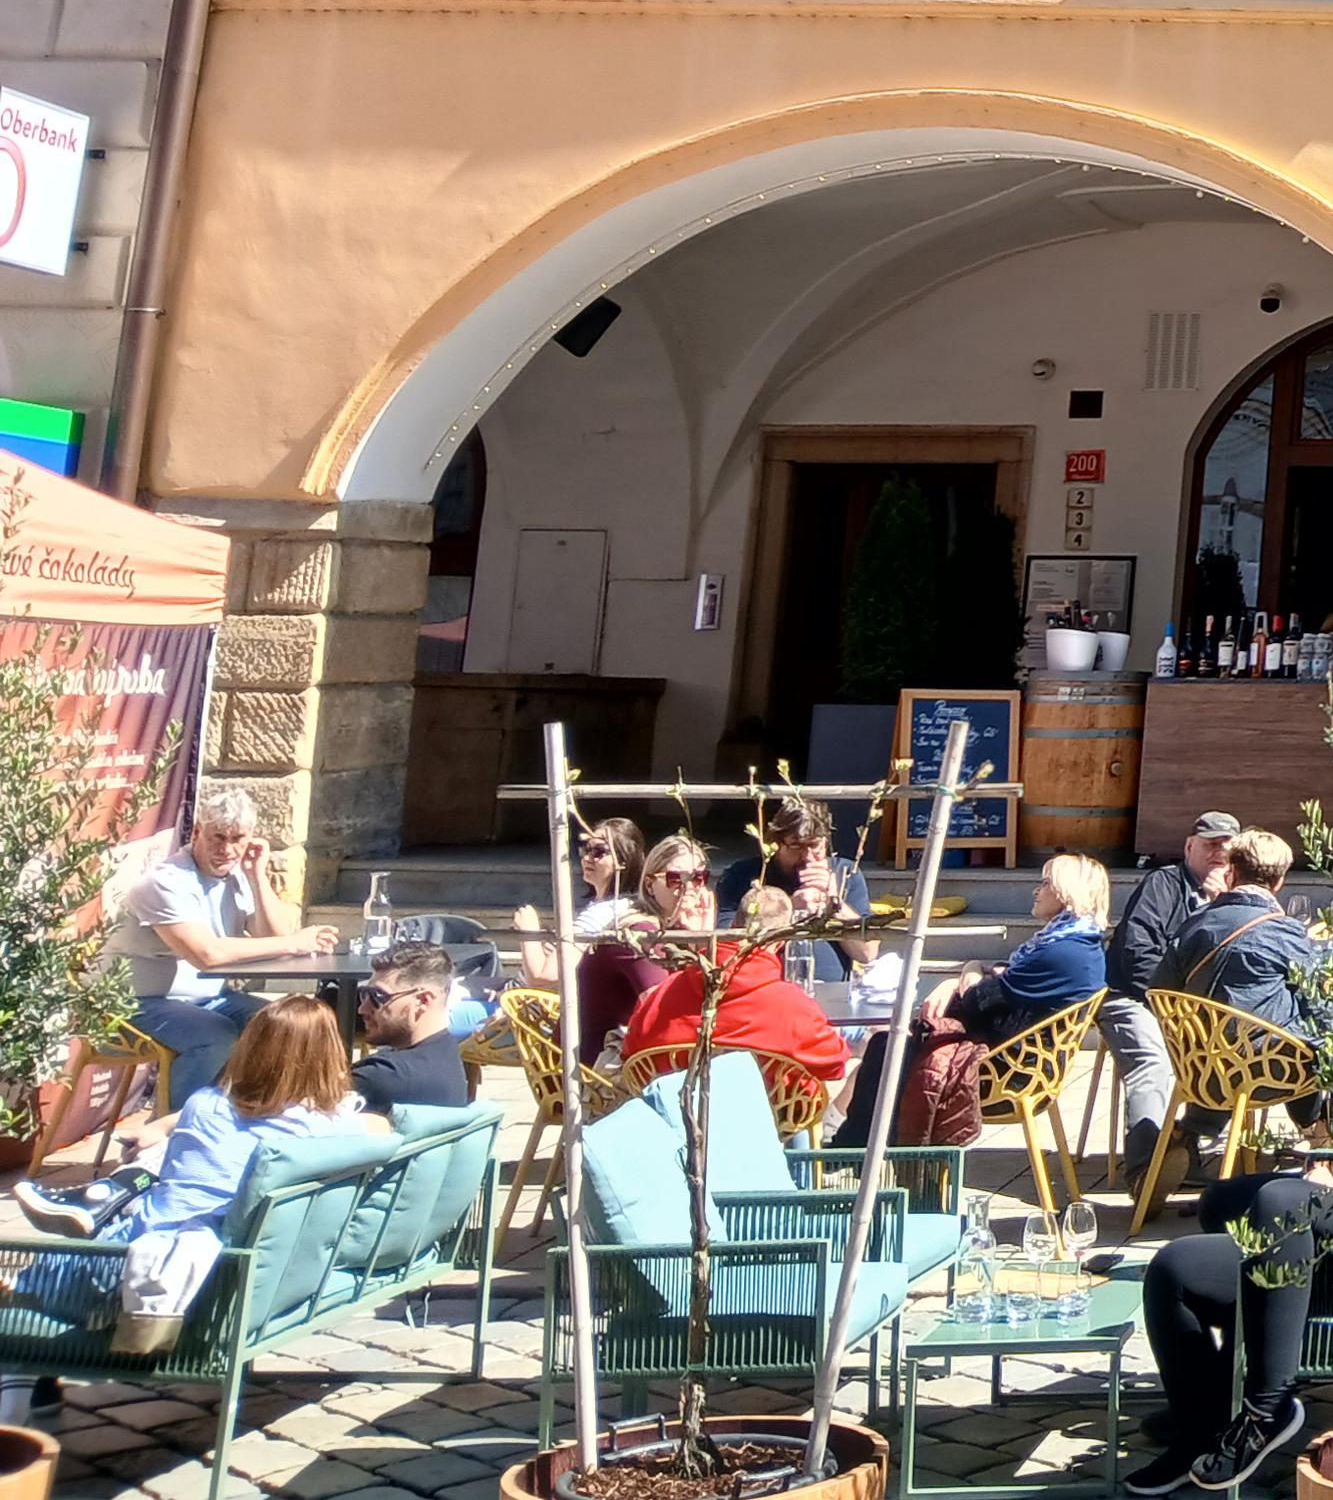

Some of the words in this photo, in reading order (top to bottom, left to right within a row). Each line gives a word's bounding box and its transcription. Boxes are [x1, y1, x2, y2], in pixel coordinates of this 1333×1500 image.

[1, 107, 78, 153] Oberbank
[1069, 455, 1097, 472] 200
[1076, 491, 1085, 505] 2
[1075, 512, 1084, 526] 3
[1073, 534, 1082, 547] 4
[37, 547, 136, 599] čokolády
